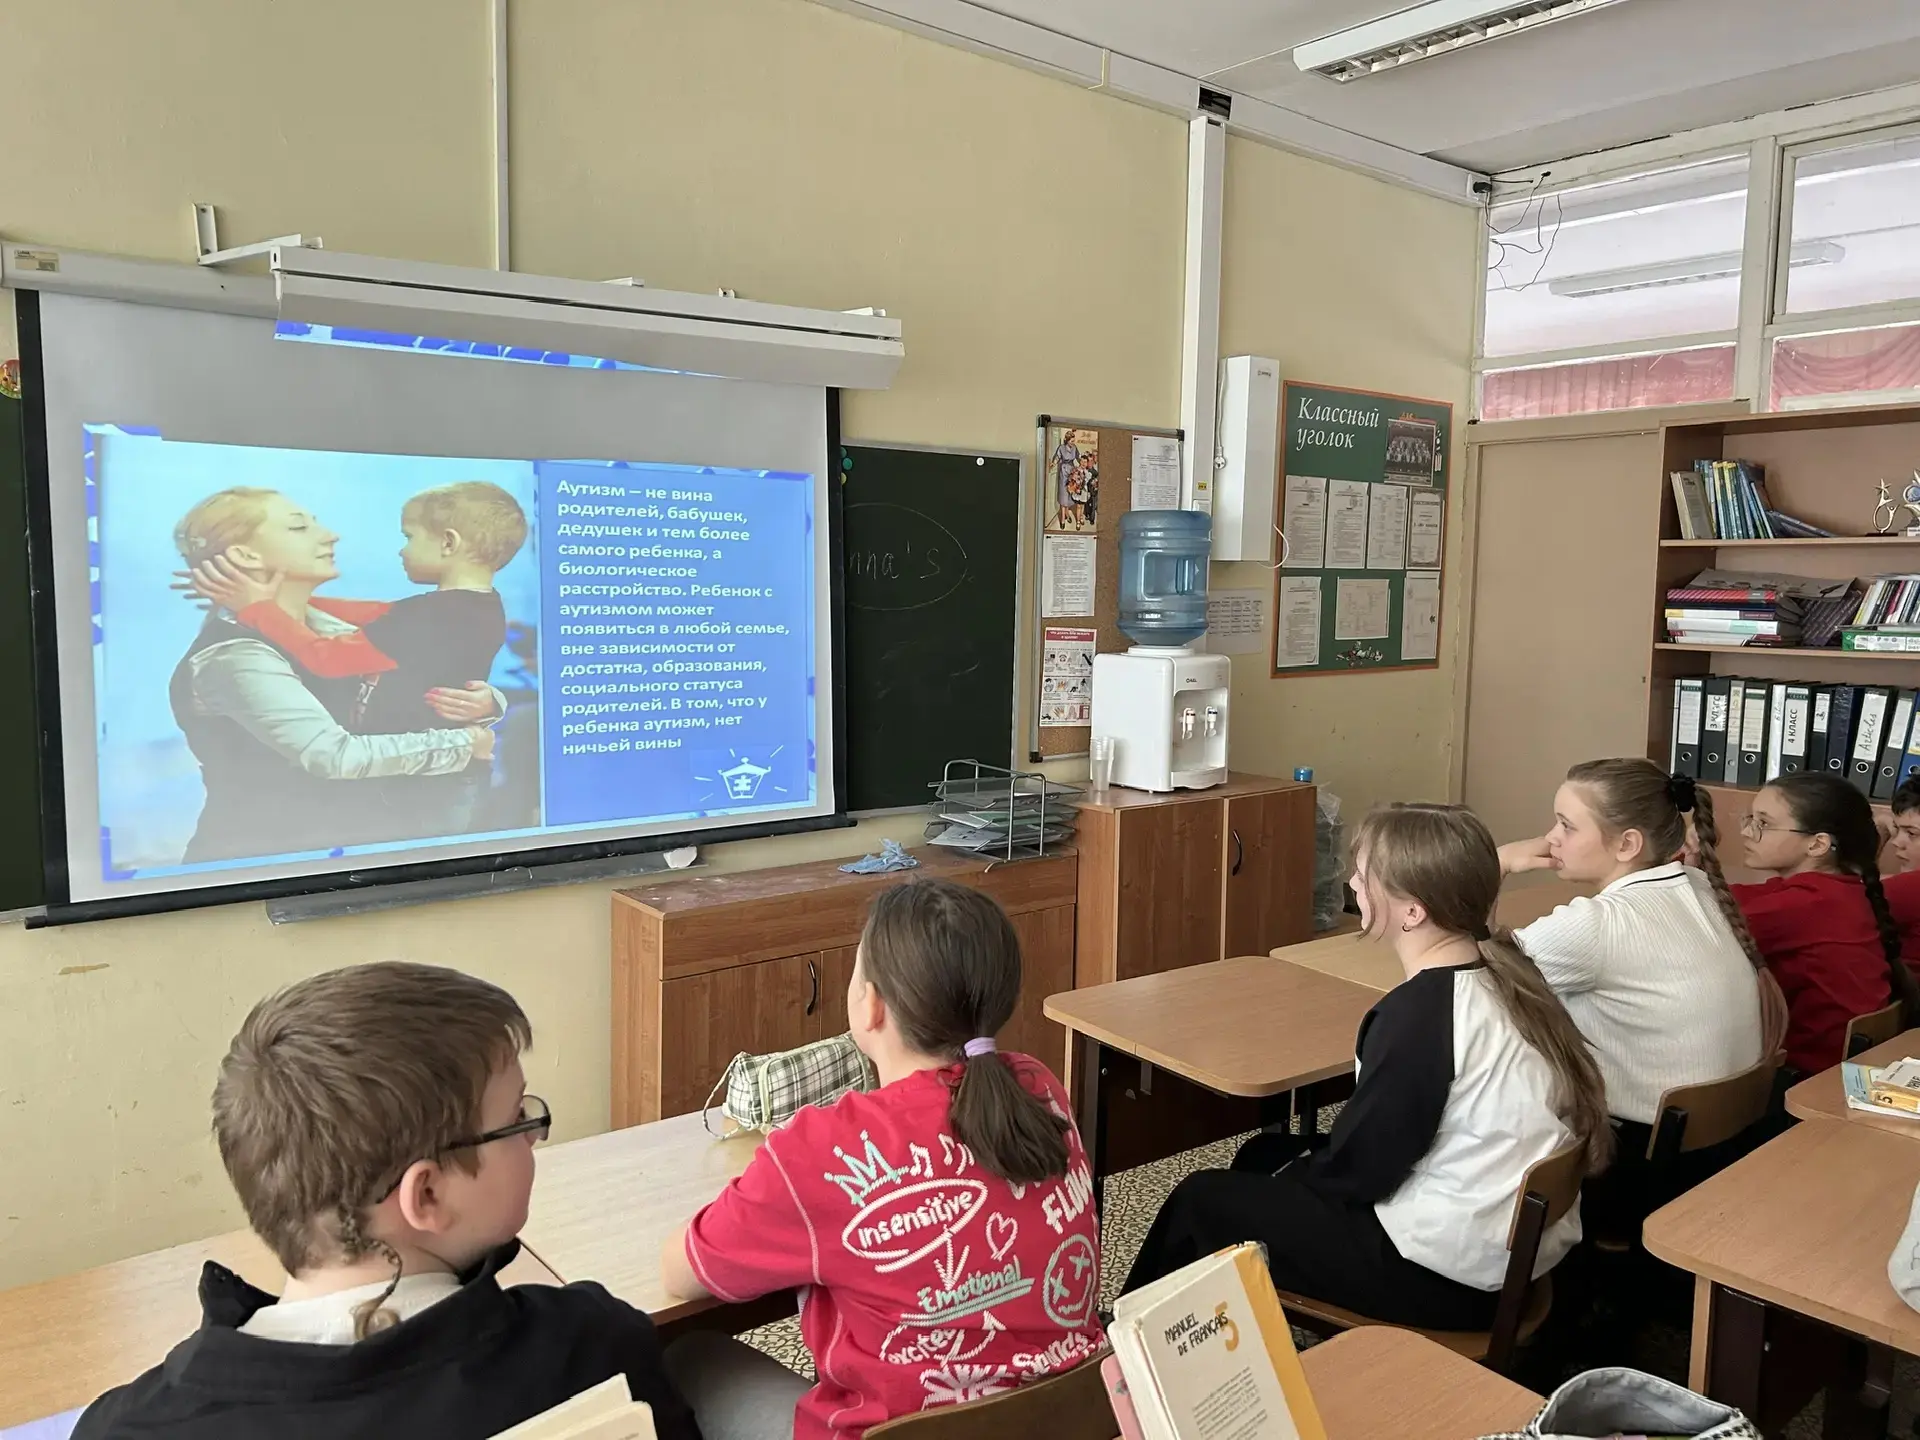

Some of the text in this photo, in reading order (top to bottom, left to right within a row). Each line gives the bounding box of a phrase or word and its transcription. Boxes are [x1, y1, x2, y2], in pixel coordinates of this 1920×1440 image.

[1298, 397, 1380, 428] Классный
[1296, 427, 1355, 451] уголок
[557, 480, 625, 497] Аутизм
[646, 488, 666, 499] не
[672, 490, 713, 502] вина
[558, 502, 748, 524] родителей, бабушек,
[558, 523, 750, 541] дедушек и тем более
[558, 544, 722, 561] самого ребенка, а
[559, 562, 697, 578] биологическое
[560, 583, 772, 598] расстройство. Ребенок с
[560, 604, 714, 618] аутизмом может
[560, 621, 790, 636] появиться в любой семье,
[561, 642, 735, 655] вне зависимости от
[560, 659, 767, 678] достатка, образования,
[561, 679, 743, 697] социального статуса
[562, 696, 767, 717] родителей. В том, что у
[562, 715, 742, 737] ребенка аутизм, нет
[1789, 708, 1798, 737] КЛАСС
[563, 738, 681, 755] ничьей вины
[917, 1254, 1021, 1312] Emotional
[1164, 1312, 1199, 1345] MANUEL
[1177, 1311, 1228, 1356] DE FRANÇAIS
[1215, 1301, 1239, 1352] 5
